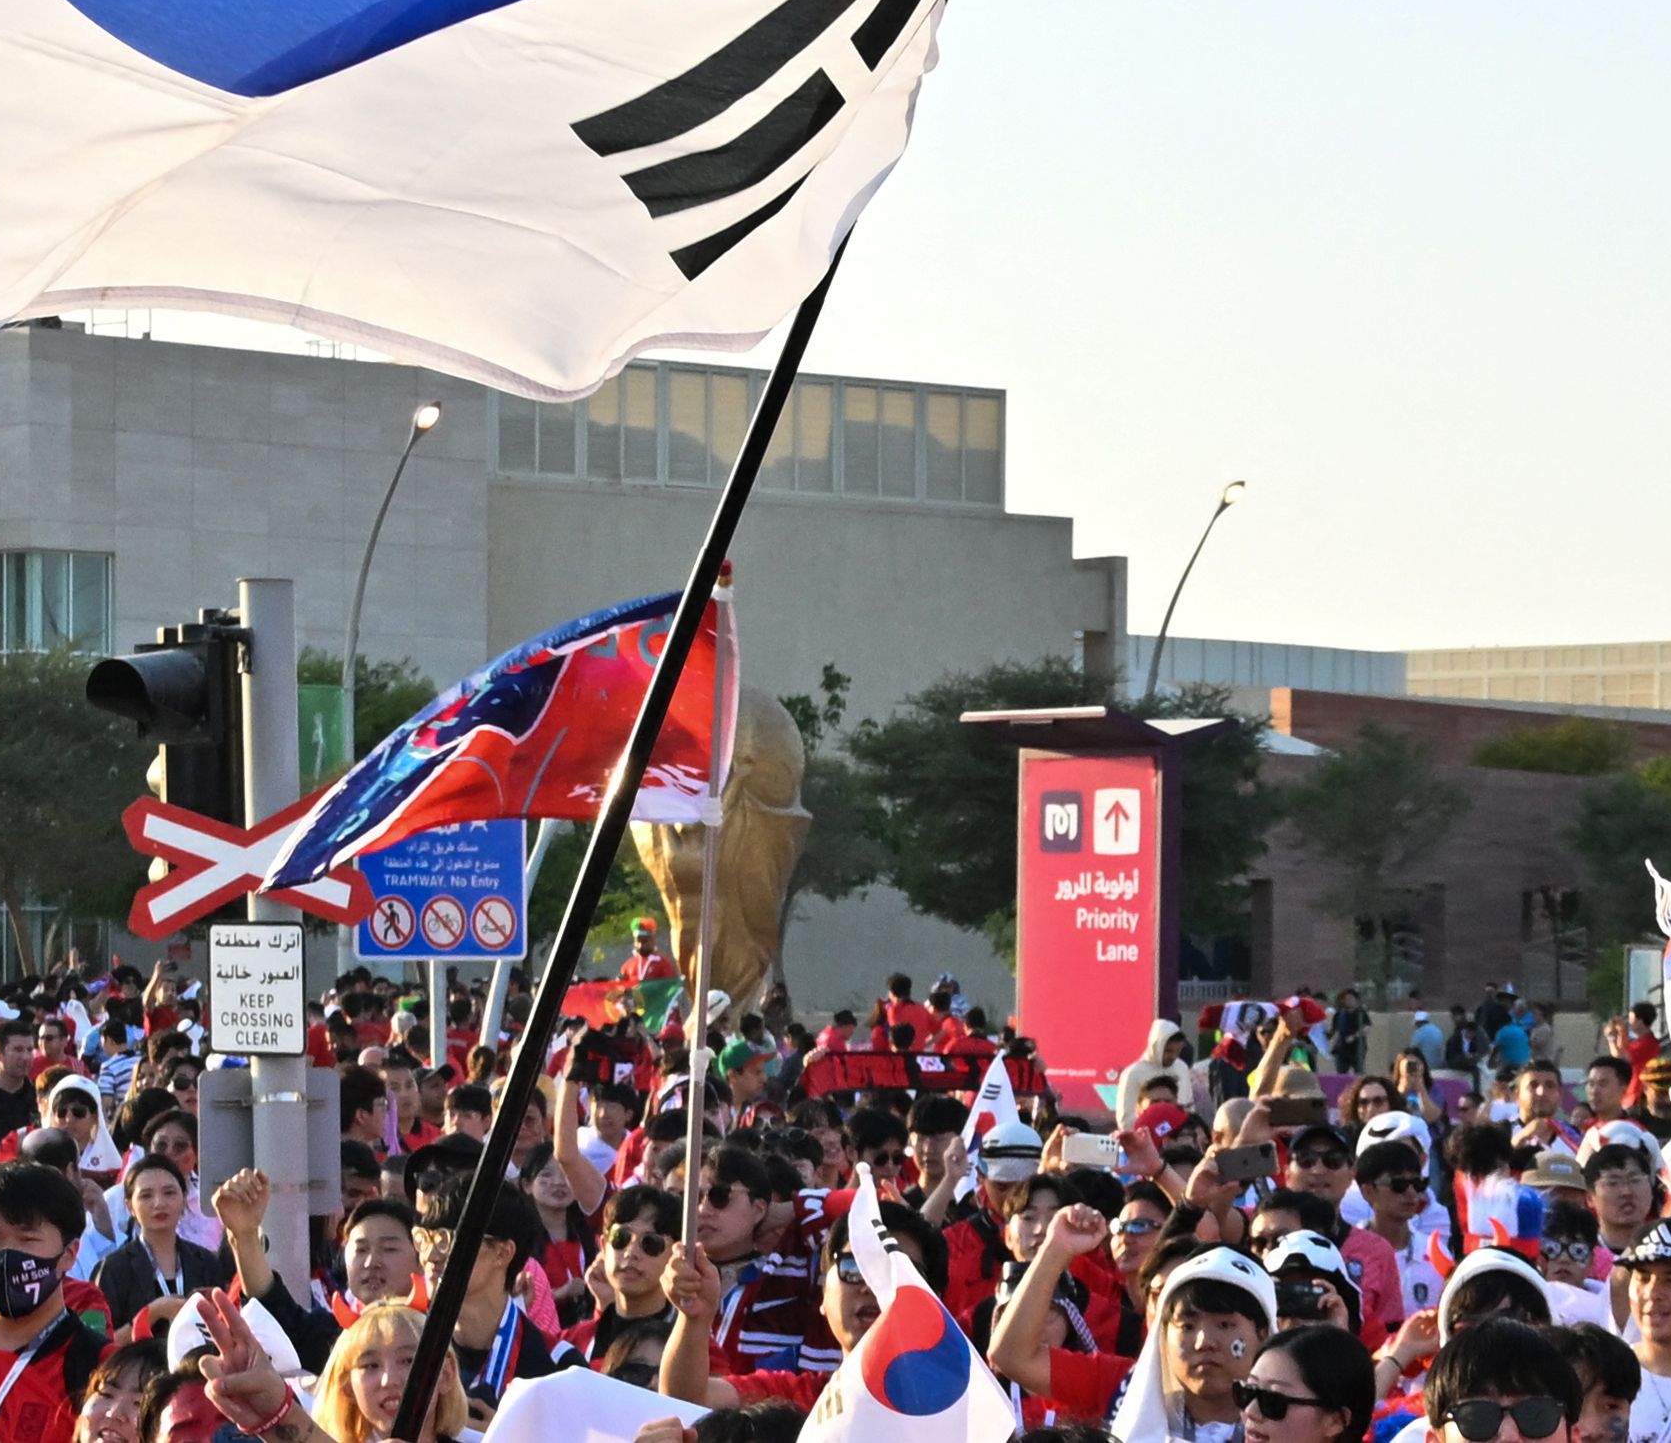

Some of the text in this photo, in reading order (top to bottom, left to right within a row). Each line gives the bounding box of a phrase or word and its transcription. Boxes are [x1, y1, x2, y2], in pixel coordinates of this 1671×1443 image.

[450, 875, 467, 888] No
[471, 875, 500, 890] Entry
[1055, 868, 1139, 900] أولوية المرور
[1076, 907, 1139, 934] Priority
[215, 932, 300, 953] اترك منطقة
[1097, 940, 1139, 961] Lane
[216, 964, 300, 984] العبور خالية
[240, 994, 274, 1008] KEEP
[220, 1011, 294, 1028] CROSSING
[235, 1030, 279, 1046] CLEAR
[30, 1266, 50, 1281] SON
[24, 1282, 40, 1305] 7
